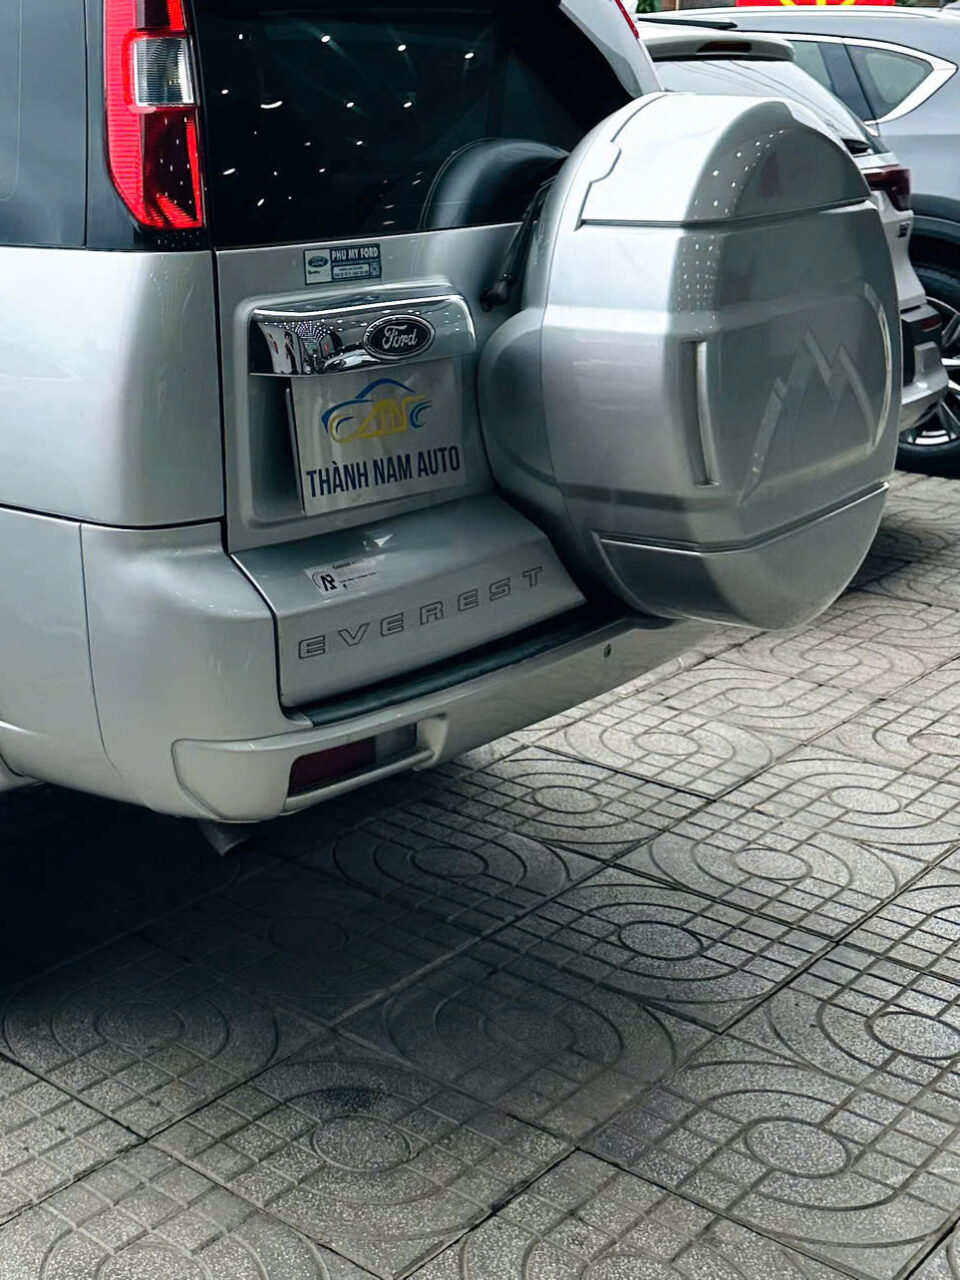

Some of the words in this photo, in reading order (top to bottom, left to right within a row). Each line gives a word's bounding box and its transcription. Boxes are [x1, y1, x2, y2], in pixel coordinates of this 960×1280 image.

[331, 250, 347, 261] PHU
[348, 248, 359, 260] MY
[360, 246, 379, 259] FORD
[382, 324, 418, 349] Ford
[305, 461, 369, 498] THÀNH
[372, 453, 413, 486] NAM
[417, 445, 461, 478] AUTO
[298, 565, 543, 660] EVEREST
